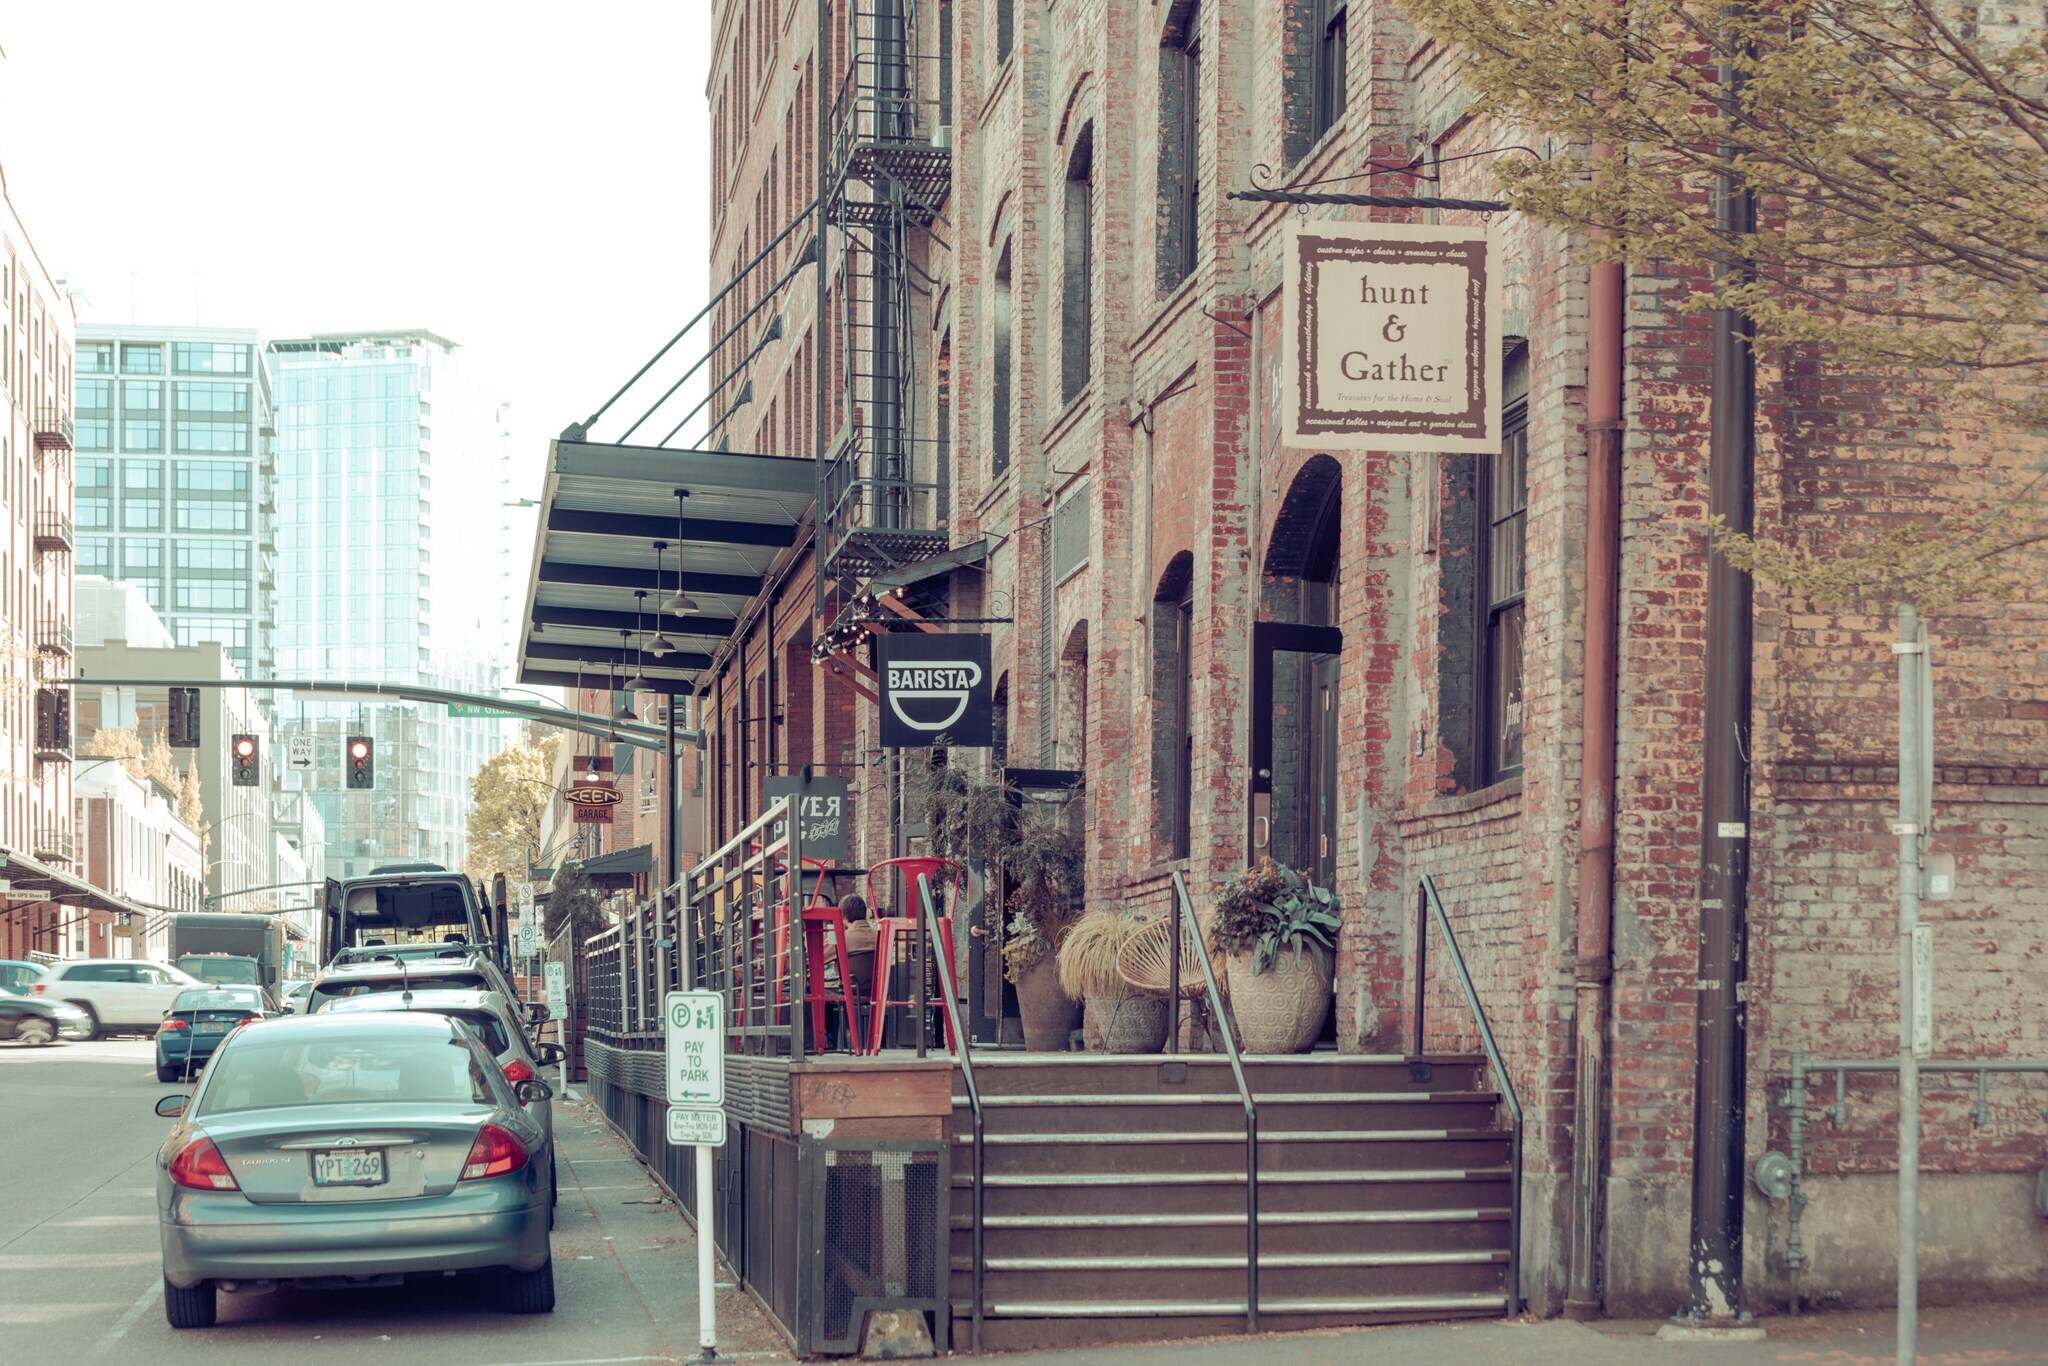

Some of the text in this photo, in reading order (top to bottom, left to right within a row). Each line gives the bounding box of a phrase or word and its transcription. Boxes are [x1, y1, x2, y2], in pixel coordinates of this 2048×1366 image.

[1316, 246, 1365, 257] custom sofas
[1373, 246, 1396, 256] chairs
[1404, 249, 1437, 257] armoires
[1445, 249, 1468, 258] chests
[1303, 261, 1314, 294] lighting
[1360, 274, 1430, 305] hunt
[1471, 278, 1481, 330] fine jewelry
[1303, 304, 1314, 363] aromatherapy
[1382, 314, 1407, 343] &
[1340, 351, 1448, 382] Gather
[1470, 339, 1481, 400] unique candles
[1303, 371, 1312, 410] ironwork
[1337, 392, 1453, 404] Treasures for the Home & Soul
[1305, 416, 1369, 426] occasional tables
[1376, 418, 1408, 429] original
[1429, 420, 1478, 430] garden decor
[888, 669, 969, 689] BARISTA
[467, 706, 480, 714] NW
[293, 738, 312, 747] ONE
[292, 748, 312, 756] WAY
[565, 789, 620, 803] KEEN
[578, 809, 609, 819] GARAGE
[684, 1041, 704, 1053] PAY
[687, 1055, 702, 1068] TO
[680, 1069, 709, 1082] PARK
[676, 1112, 717, 1122] PAY METER
[702, 1131, 713, 1139] SUN
[317, 1157, 380, 1178] YPT 269
